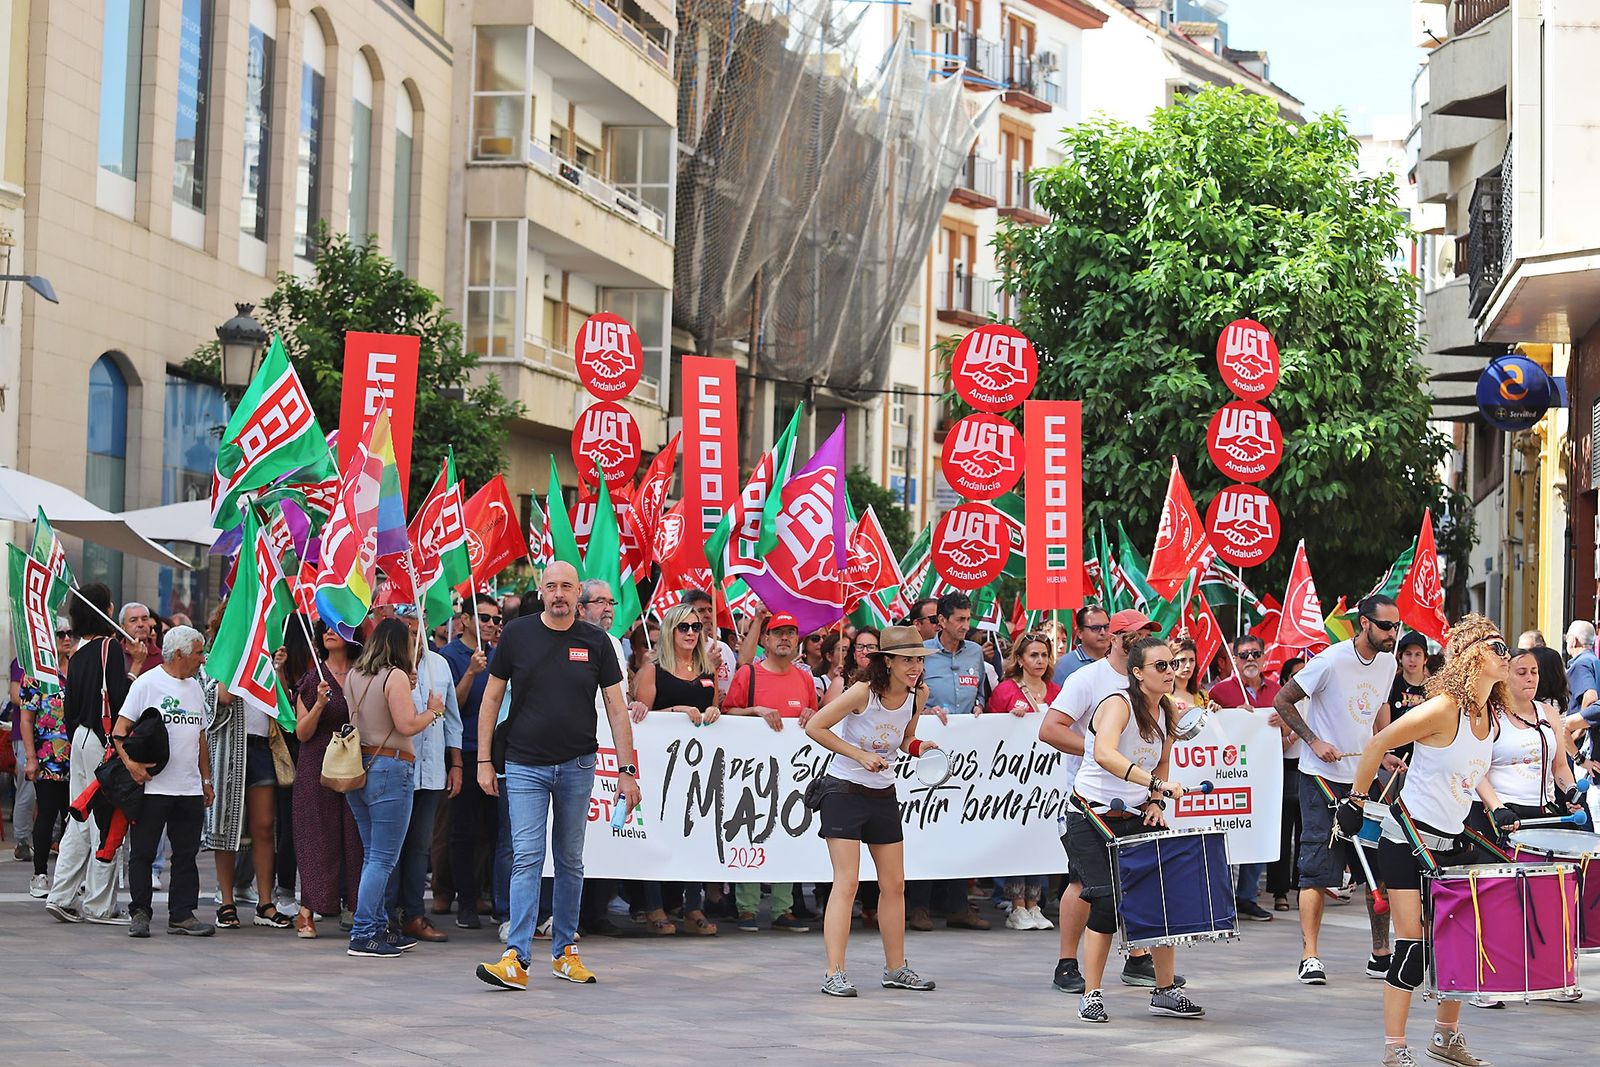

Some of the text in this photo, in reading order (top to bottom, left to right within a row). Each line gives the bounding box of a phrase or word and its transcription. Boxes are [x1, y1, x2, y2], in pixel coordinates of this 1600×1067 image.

[585, 320, 632, 355] UGT
[1226, 325, 1270, 361] UGT
[965, 331, 1027, 369] UGT
[590, 378, 627, 391] Andalucía
[969, 387, 1014, 404] Andalucía
[1232, 377, 1265, 392] Andalucía
[583, 409, 631, 444] UGT
[1218, 408, 1272, 442] UGT
[955, 420, 1015, 458] UGT
[588, 467, 625, 481] Analucía
[1225, 460, 1266, 474] Andalucía
[956, 476, 1001, 491] Andalucía
[574, 502, 636, 537] UT
[1217, 491, 1270, 525] UGT
[944, 510, 1000, 546] UGT
[1223, 544, 1263, 558] Andalucía
[946, 565, 988, 580] Andalucía
[988, 740, 1061, 784] bajar
[1174, 745, 1219, 768] UGT
[729, 757, 755, 781] DE
[1215, 767, 1248, 779] Huelva
[587, 797, 612, 822] GT
[612, 827, 647, 839] Huelva
[1213, 817, 1252, 830] Huelva
[727, 847, 766, 869] 2023
